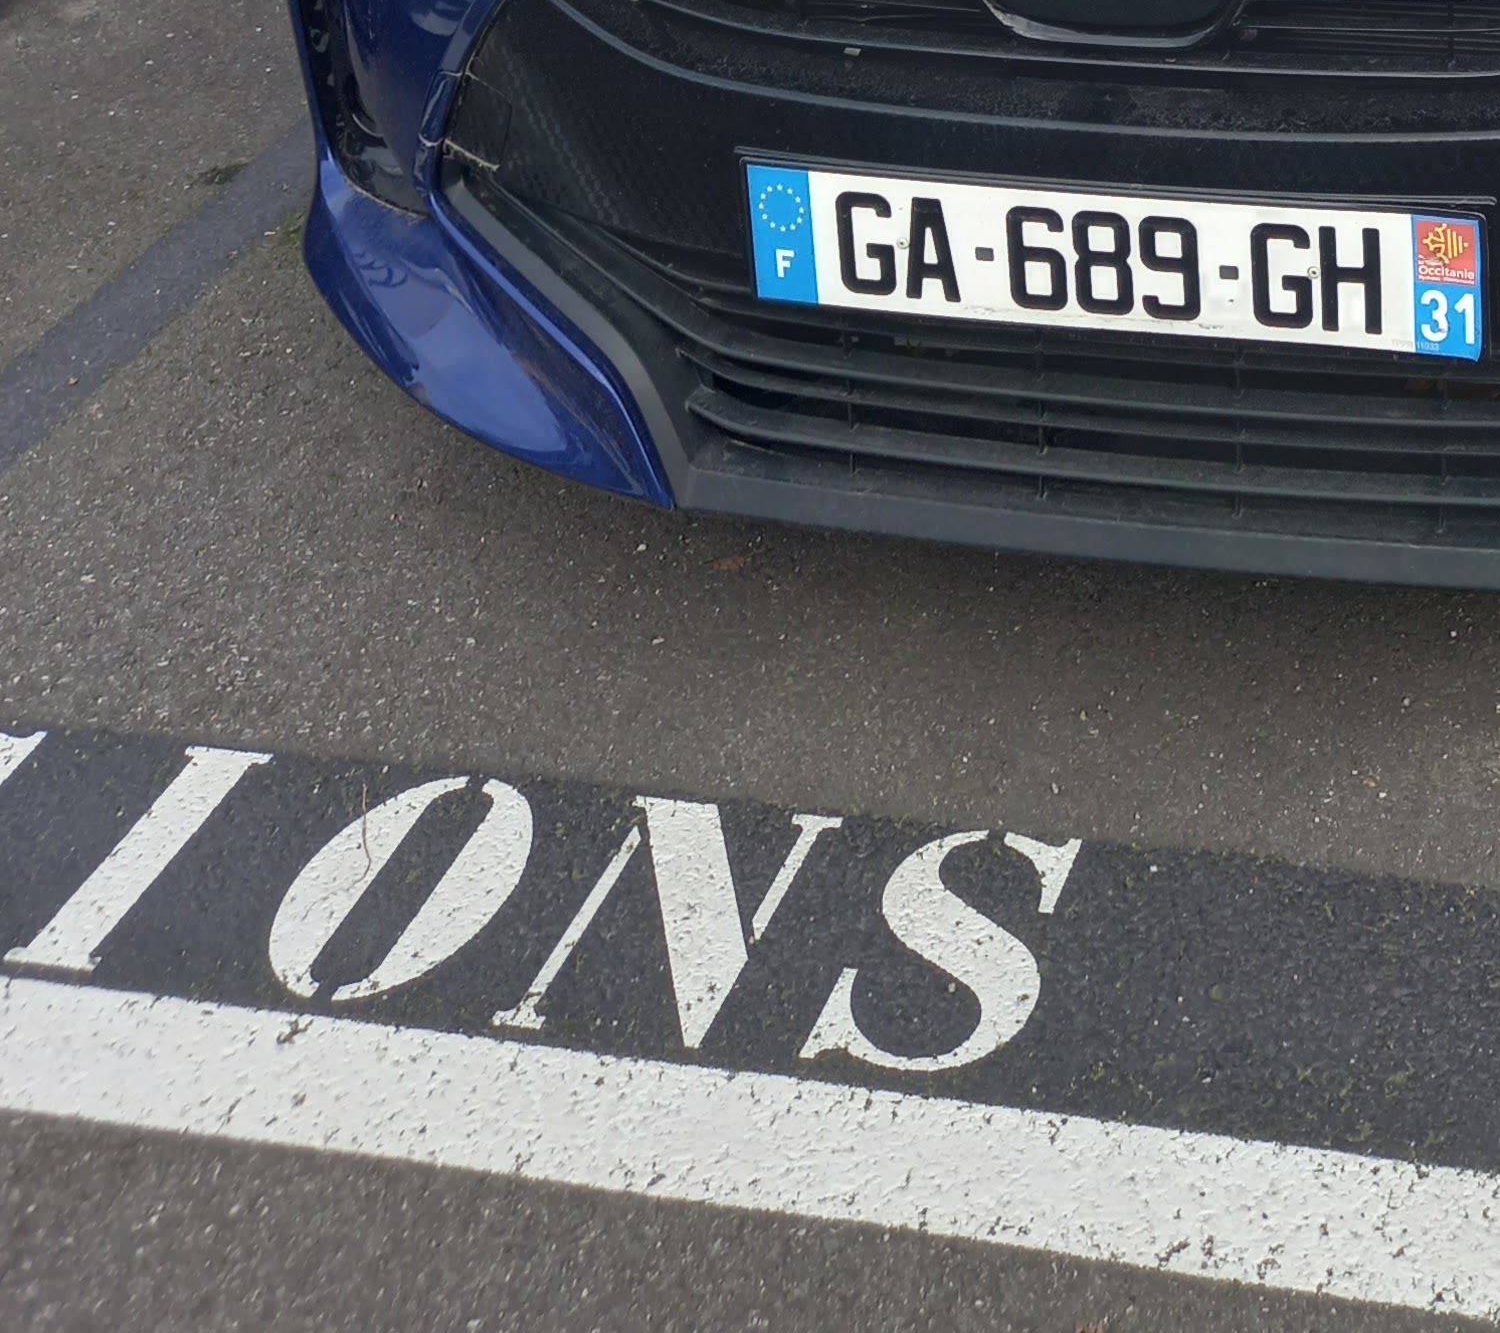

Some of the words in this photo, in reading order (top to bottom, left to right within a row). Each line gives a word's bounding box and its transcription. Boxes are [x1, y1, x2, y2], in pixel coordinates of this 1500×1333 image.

[775, 248, 796, 278] F
[834, 190, 1384, 336] GA-689-GH
[1418, 265, 1475, 280] Occitanie
[1420, 289, 1476, 345] 31
[0, 731, 1082, 1073] IONS
